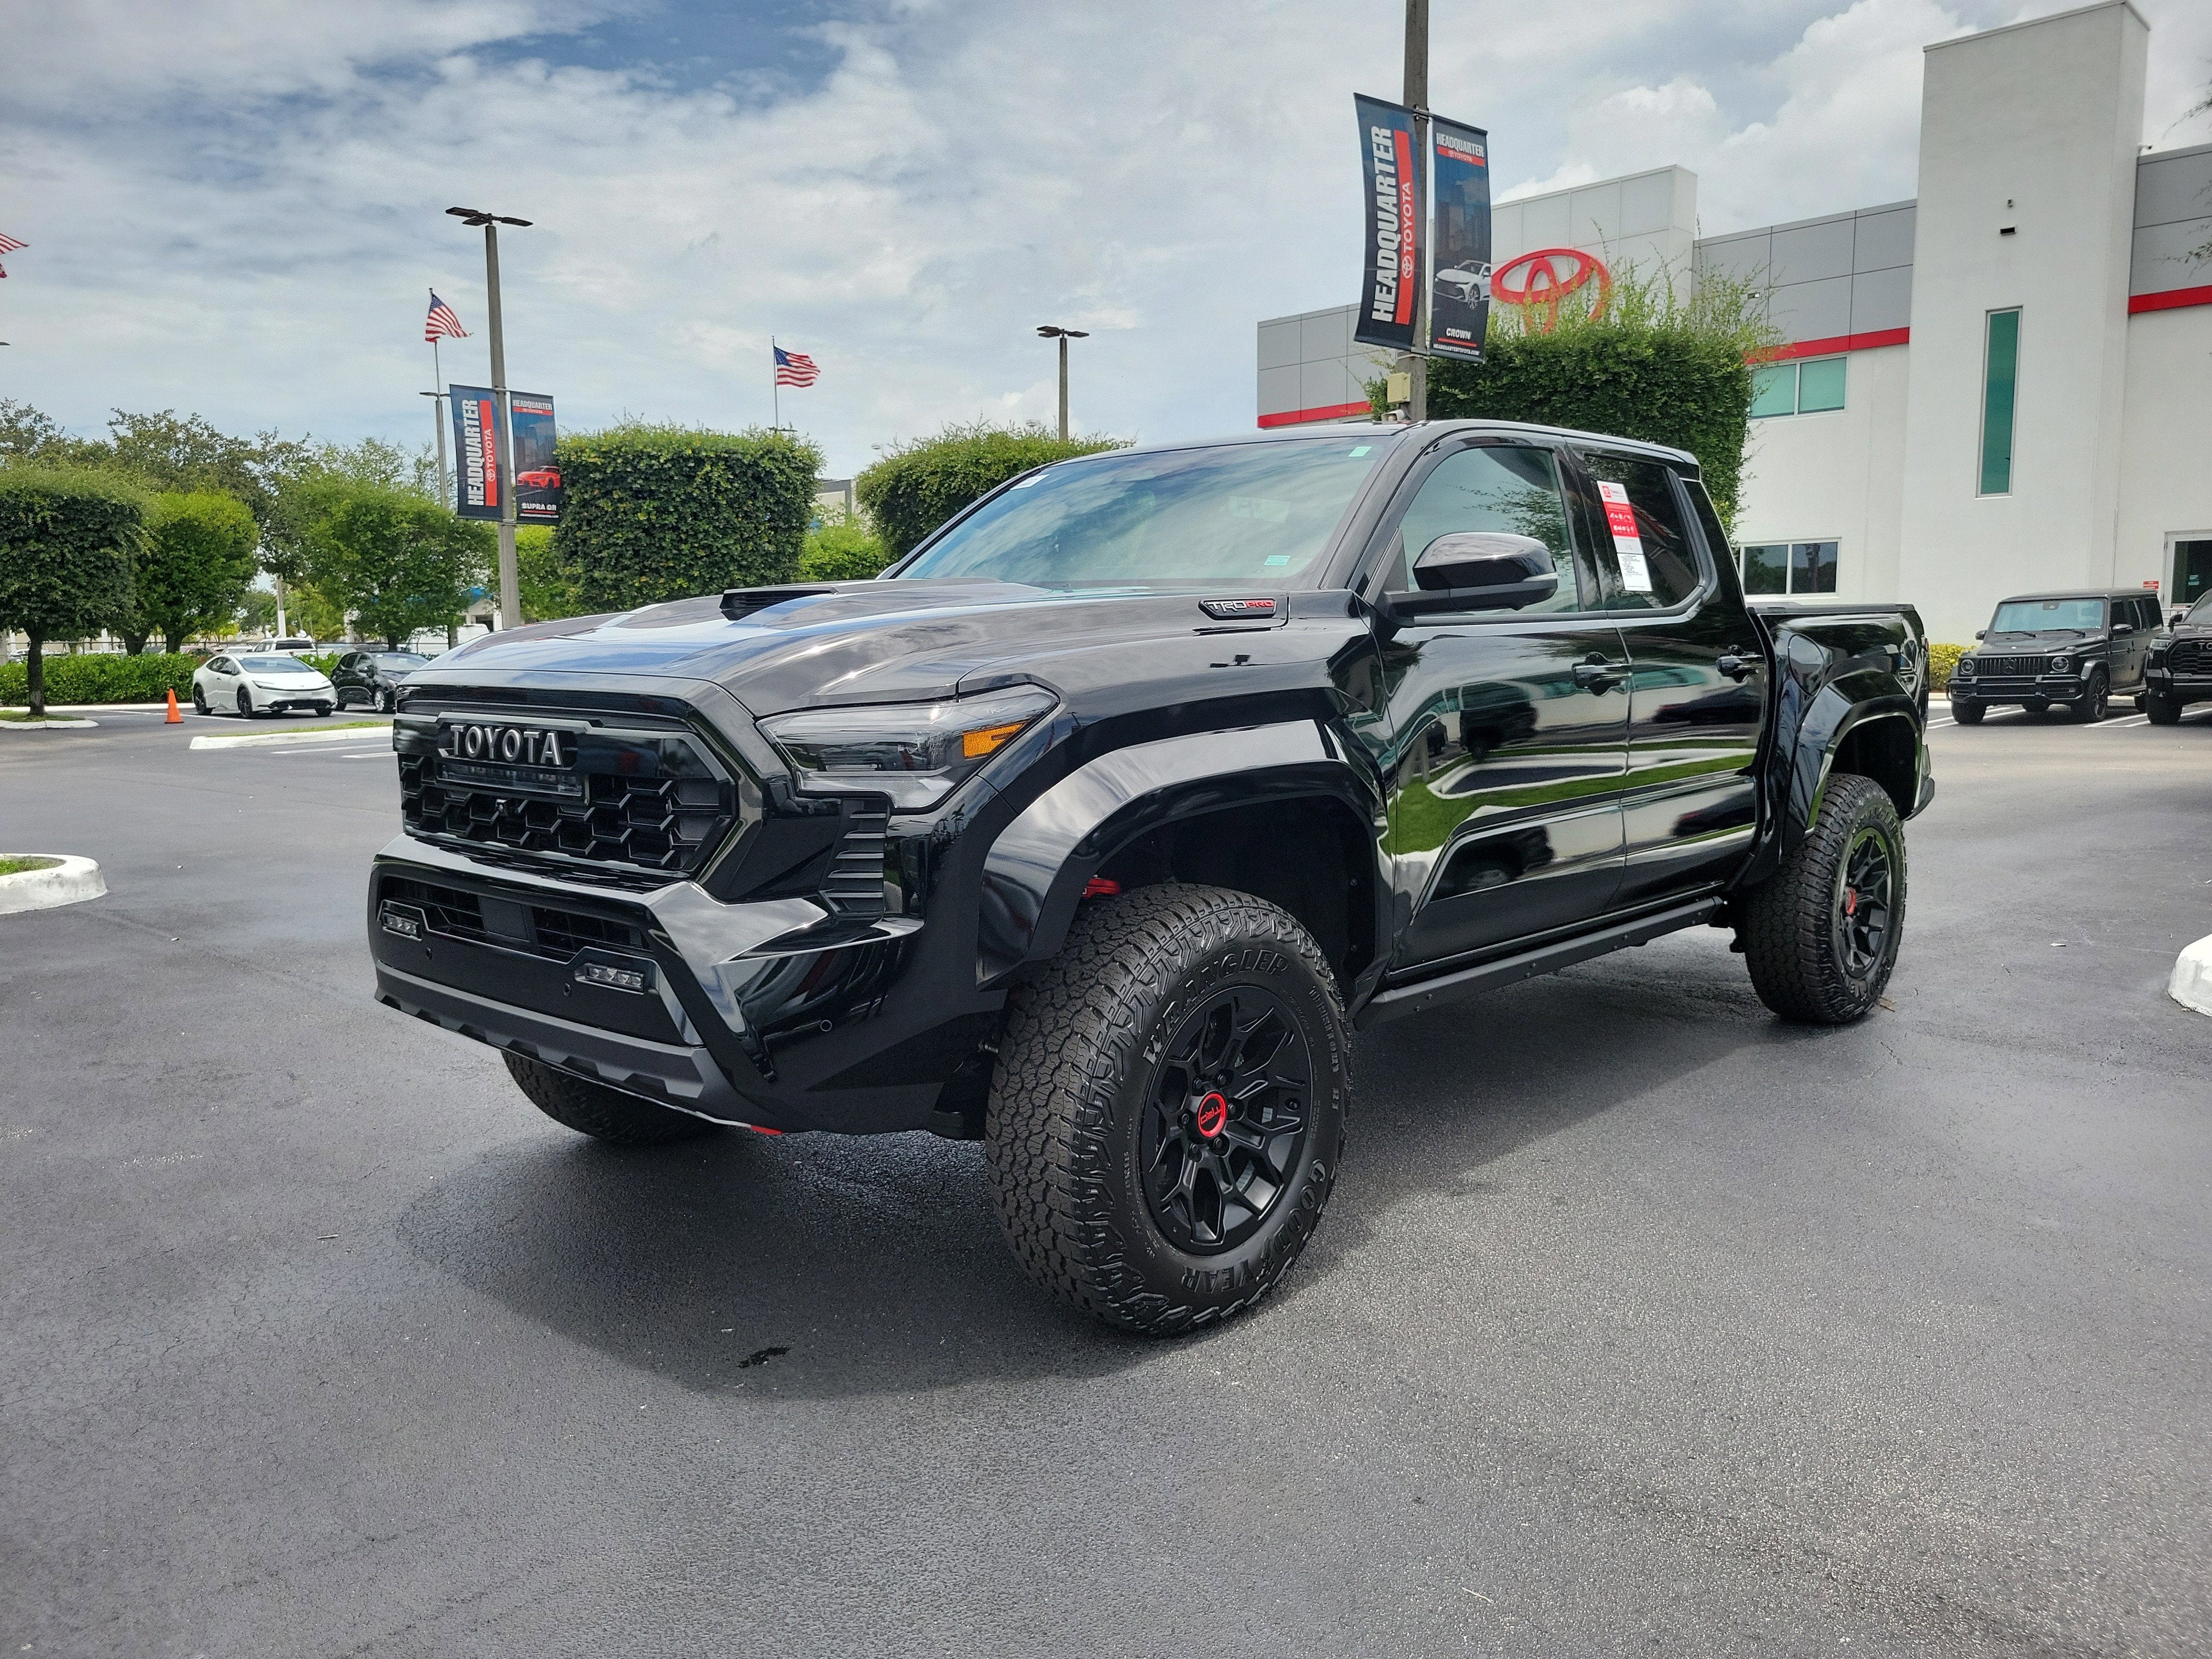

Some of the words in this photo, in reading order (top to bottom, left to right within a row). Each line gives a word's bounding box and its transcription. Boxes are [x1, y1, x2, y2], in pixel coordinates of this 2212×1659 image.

[1436, 132, 1485, 159] HEADQUARTER
[1453, 152, 1472, 162] TOYOTA
[1371, 125, 1401, 323] HEADQUARTER
[1402, 182, 1413, 253] TOYOTA
[1446, 327, 1472, 340] CROWN
[513, 399, 553, 410] HEADQUARTER
[462, 399, 485, 506] HEADQUARTER
[484, 429, 495, 467] TOYOTA
[522, 501, 546, 510] SUPRA
[450, 725, 563, 766] TOYOTA
